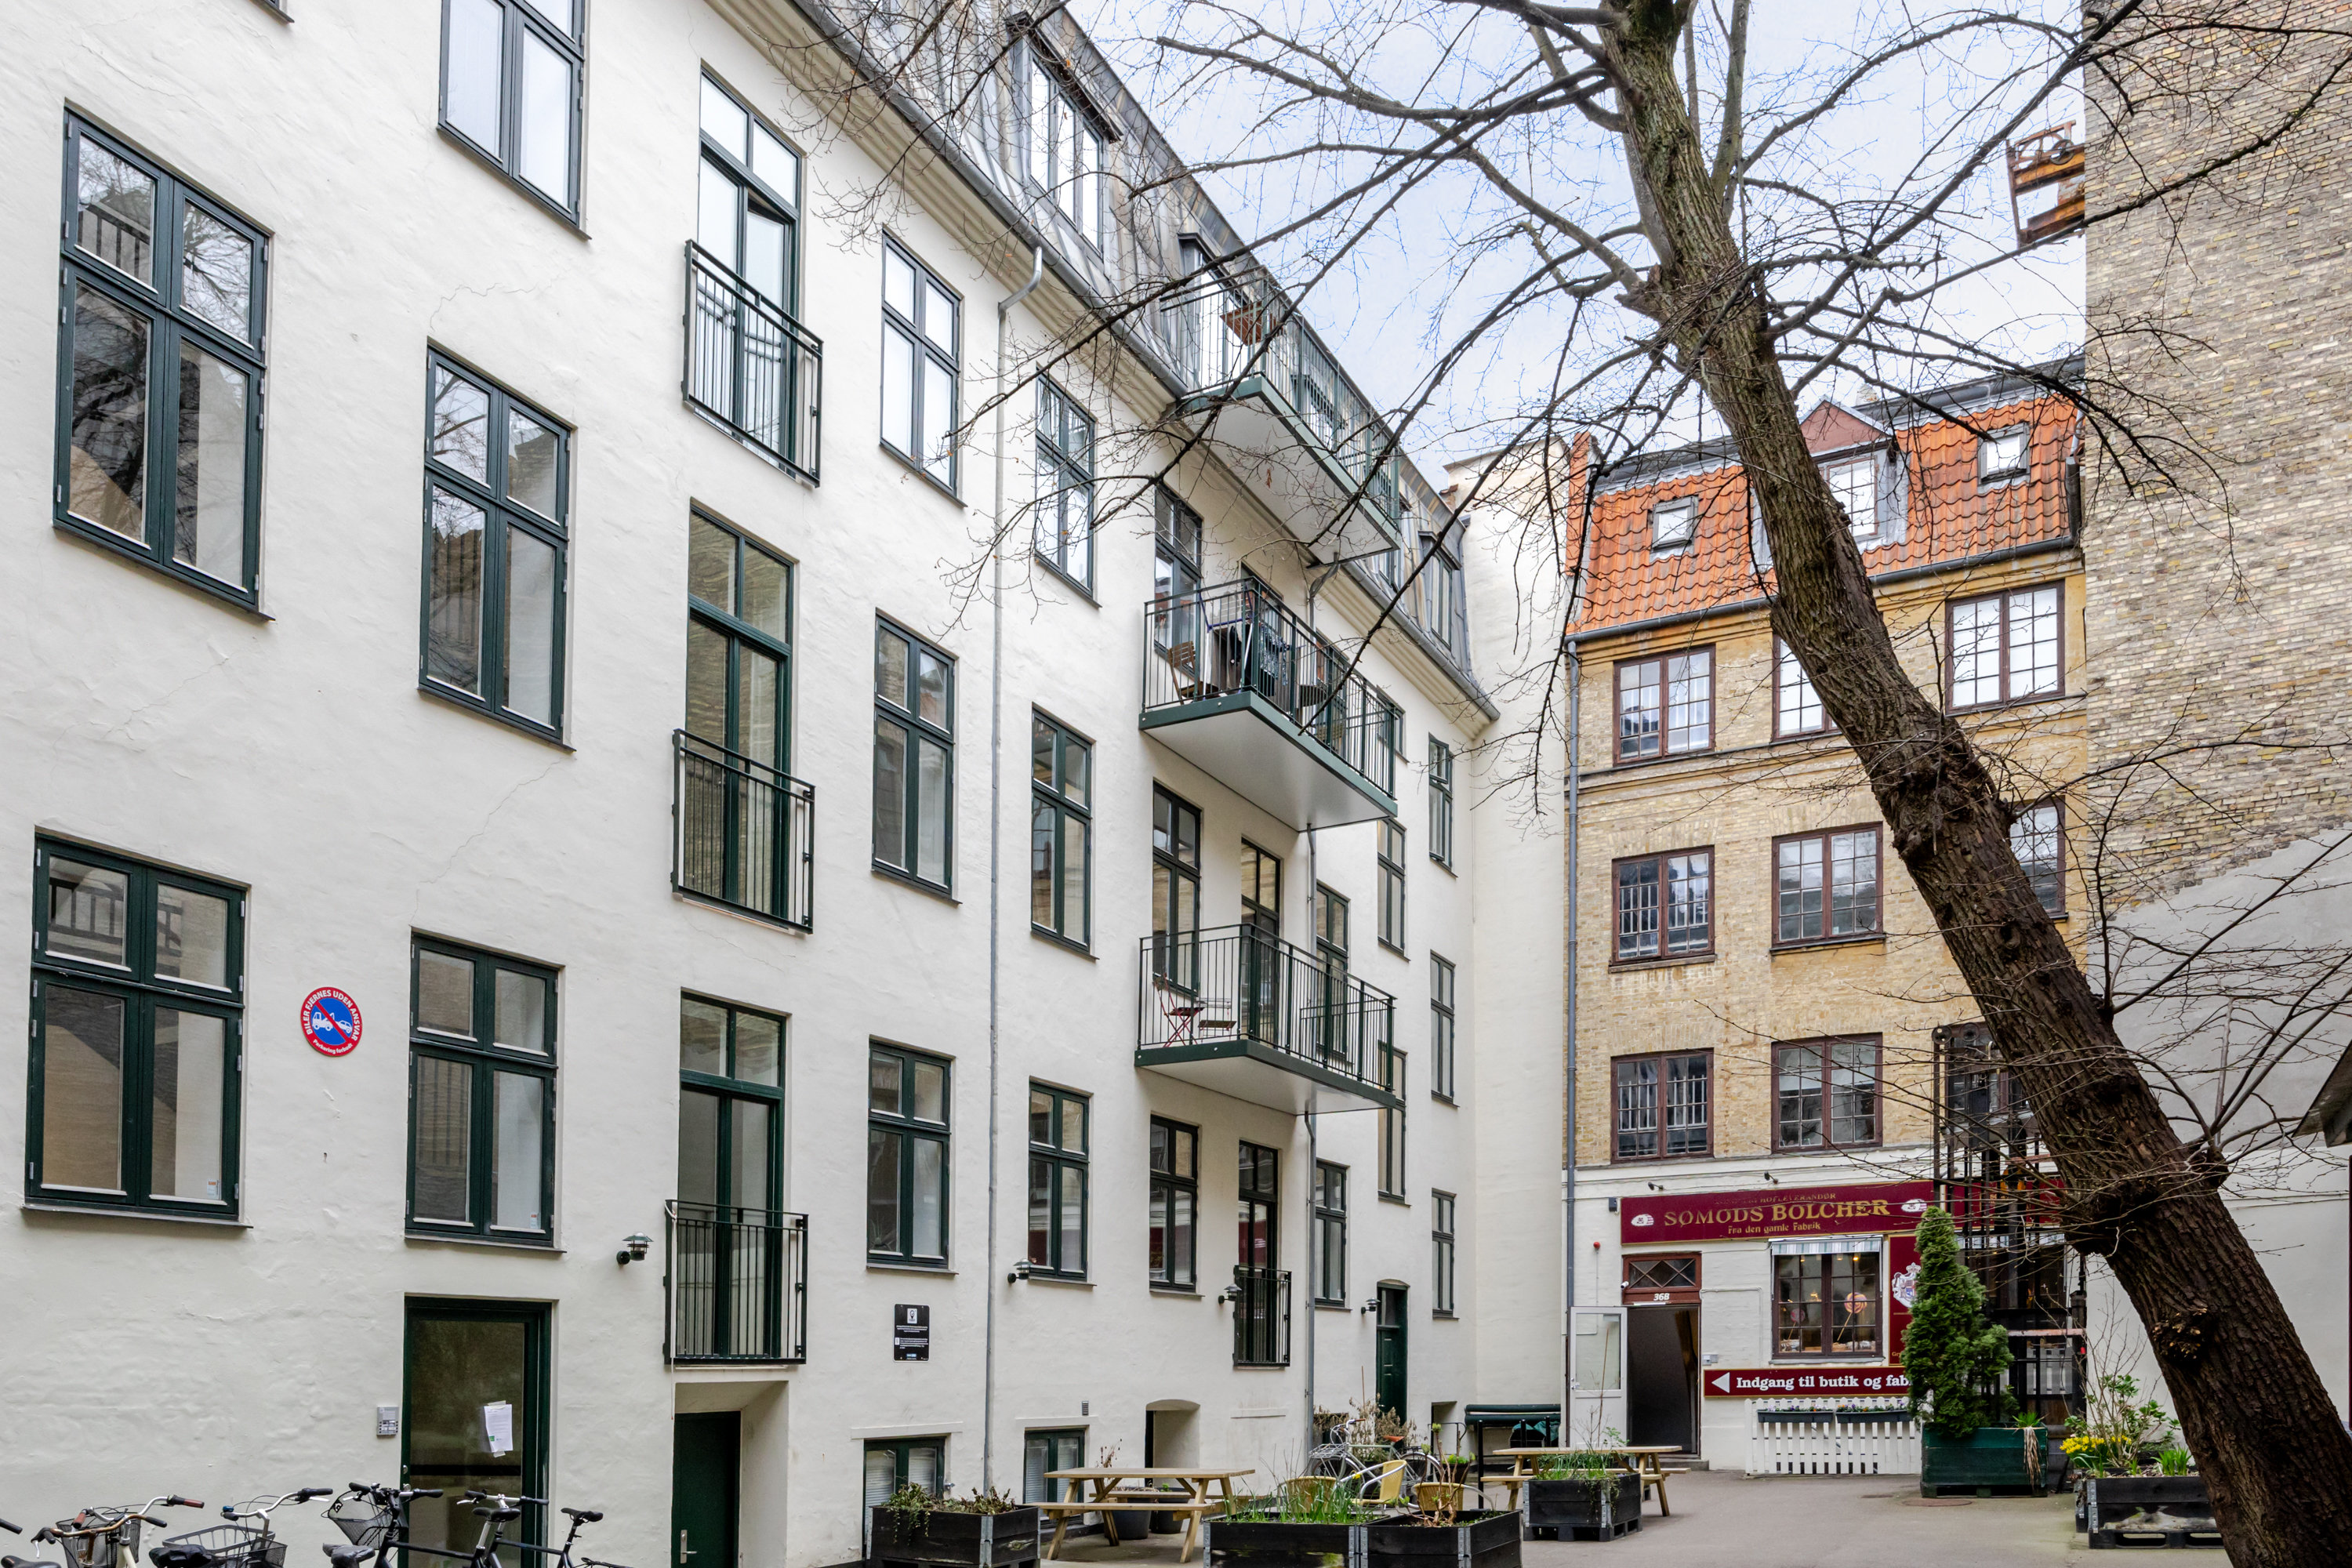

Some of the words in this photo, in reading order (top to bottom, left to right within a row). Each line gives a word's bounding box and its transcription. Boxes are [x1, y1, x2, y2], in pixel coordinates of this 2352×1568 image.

[305, 989, 332, 1010] FJERNES
[332, 990, 353, 1007] UDEN
[303, 1011, 313, 1035] BILER
[350, 1008, 360, 1041] ANSVAR
[313, 1039, 336, 1054] Parkering
[336, 1043, 353, 1053] forbudt
[1664, 1206, 1764, 1228] SØMODS
[1772, 1199, 1891, 1221] BOLCHER
[1728, 1225, 1742, 1234] Fra
[1745, 1225, 1761, 1233] den
[1763, 1224, 1789, 1234] gamle
[1793, 1221, 1821, 1232] Fabrik
[1653, 1293, 1670, 1301] 36B
[1736, 1377, 1795, 1391] Indgang
[1798, 1376, 1815, 1388] til
[1819, 1375, 1860, 1388] butik
[1863, 1377, 1882, 1390] og
